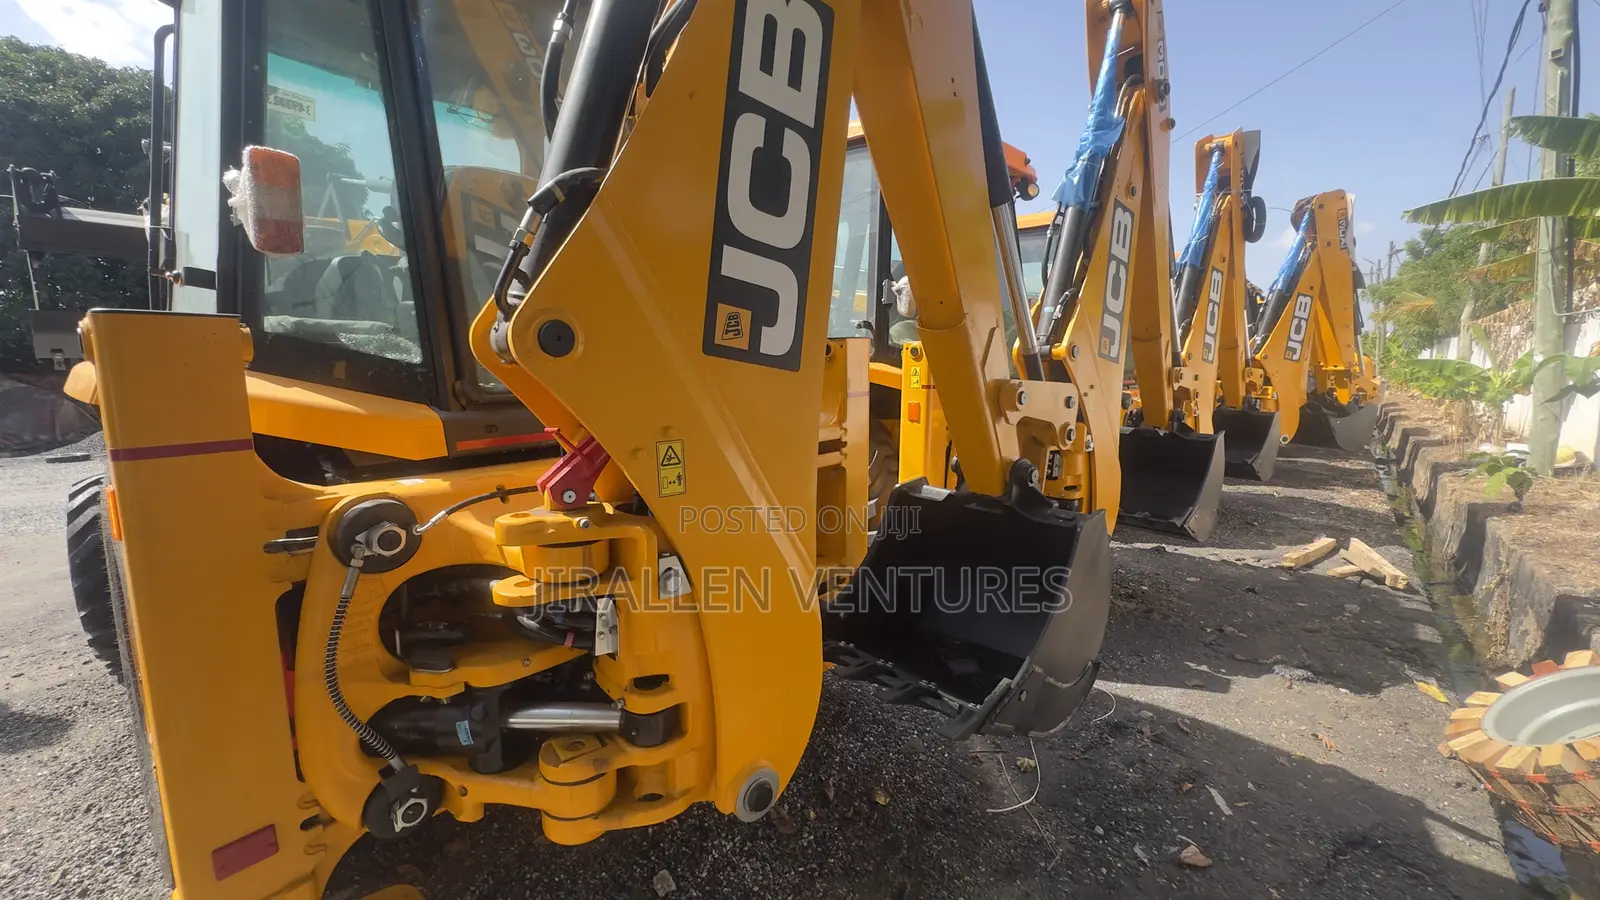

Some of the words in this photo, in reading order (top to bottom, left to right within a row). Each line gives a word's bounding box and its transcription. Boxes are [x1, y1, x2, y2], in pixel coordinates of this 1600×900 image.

[720, 0, 823, 356] JCB
[724, 313, 741, 337] JCB
[1103, 206, 1132, 359] JCB
[1204, 270, 1223, 361] JCB
[1287, 295, 1312, 361] JCB
